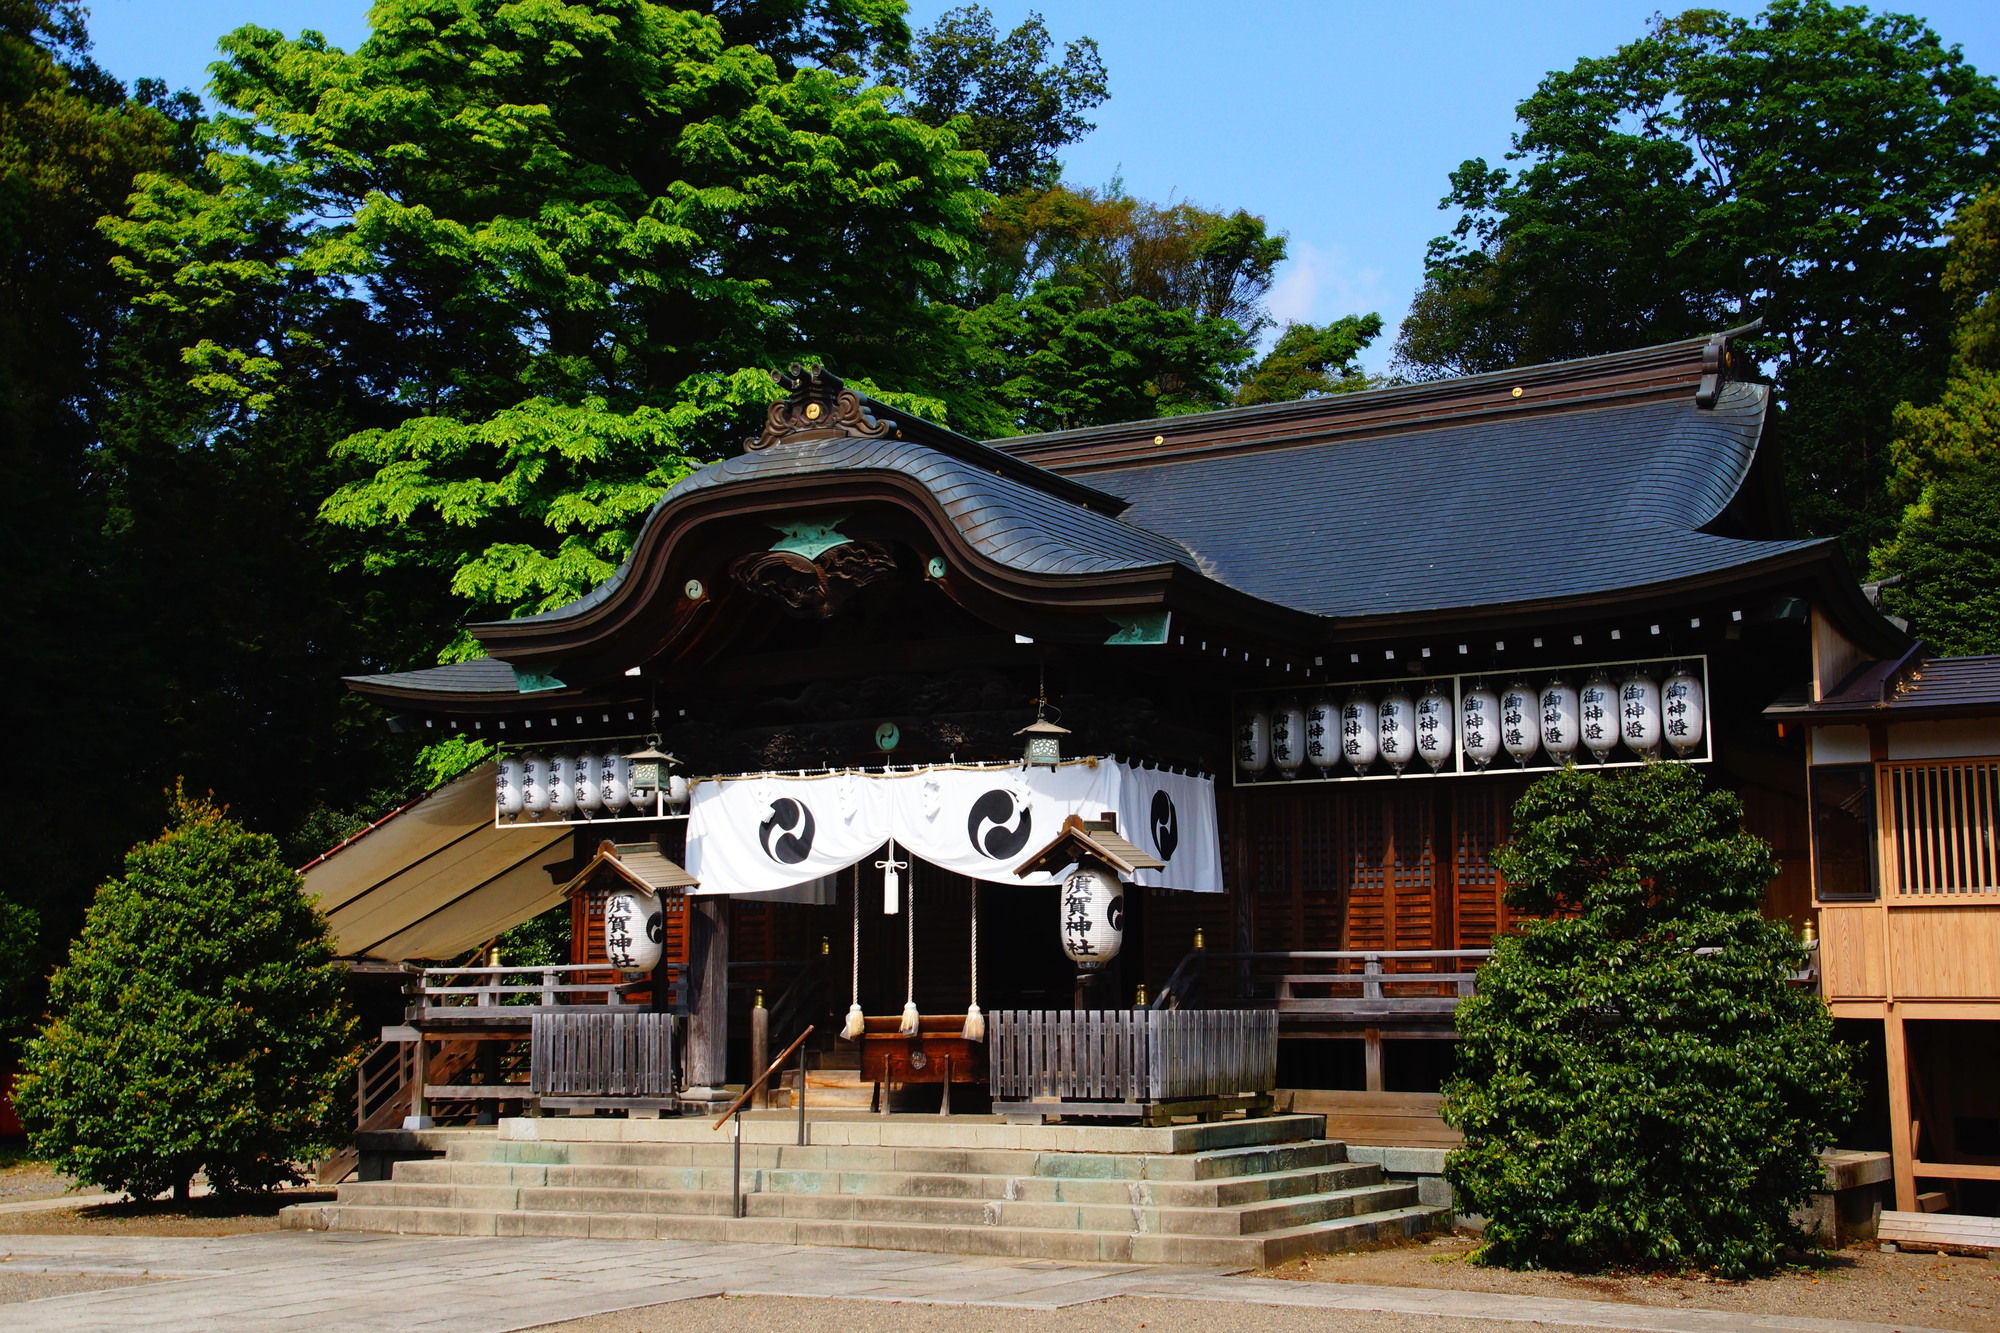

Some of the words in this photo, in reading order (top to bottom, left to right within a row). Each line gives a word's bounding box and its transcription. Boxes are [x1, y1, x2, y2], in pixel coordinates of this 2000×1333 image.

[1306, 707, 1325, 757] 御神燈
[1343, 704, 1363, 755] 御神燈
[1380, 702, 1399, 753] 御神燈
[1418, 699, 1439, 751] 御神燈
[1464, 696, 1485, 748] 御神燈
[1503, 693, 1524, 746] 御神燈
[1542, 691, 1563, 744] 御神燈
[1583, 688, 1604, 739] 御神燈
[1623, 685, 1645, 738] 御神燈
[1665, 682, 1688, 736] 御神燈
[602, 756, 615, 800] 御神燈
[608, 895, 640, 969] 須賀神社
[1064, 875, 1099, 957] 須賀神社
